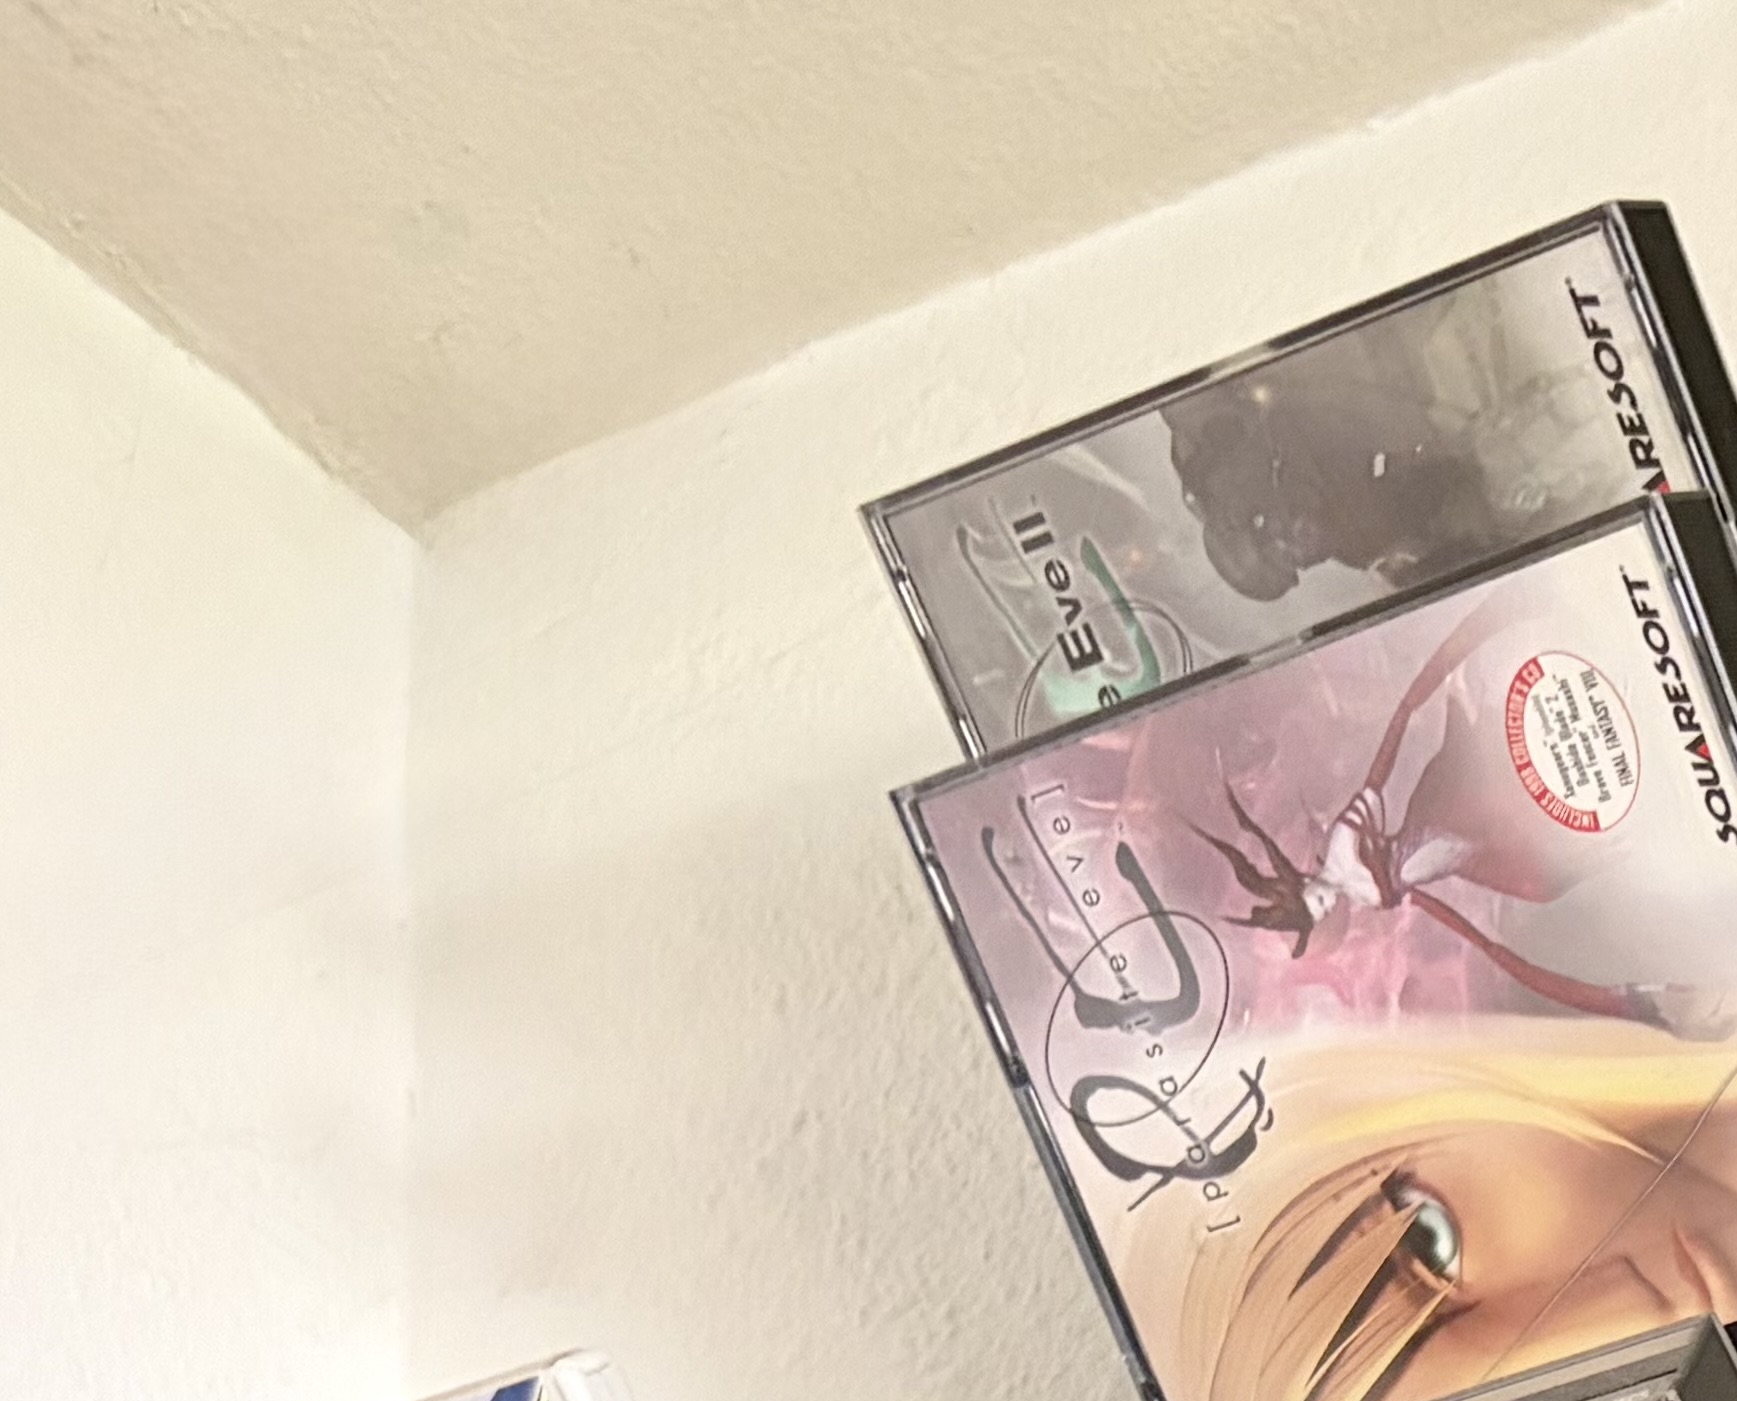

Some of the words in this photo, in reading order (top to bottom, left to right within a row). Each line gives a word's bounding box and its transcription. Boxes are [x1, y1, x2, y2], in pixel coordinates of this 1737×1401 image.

[1012, 511, 1055, 554] II
[1044, 558, 1104, 674] Eve
[1591, 699, 1621, 751] FANTASY
[1612, 750, 1635, 787] FINAL
